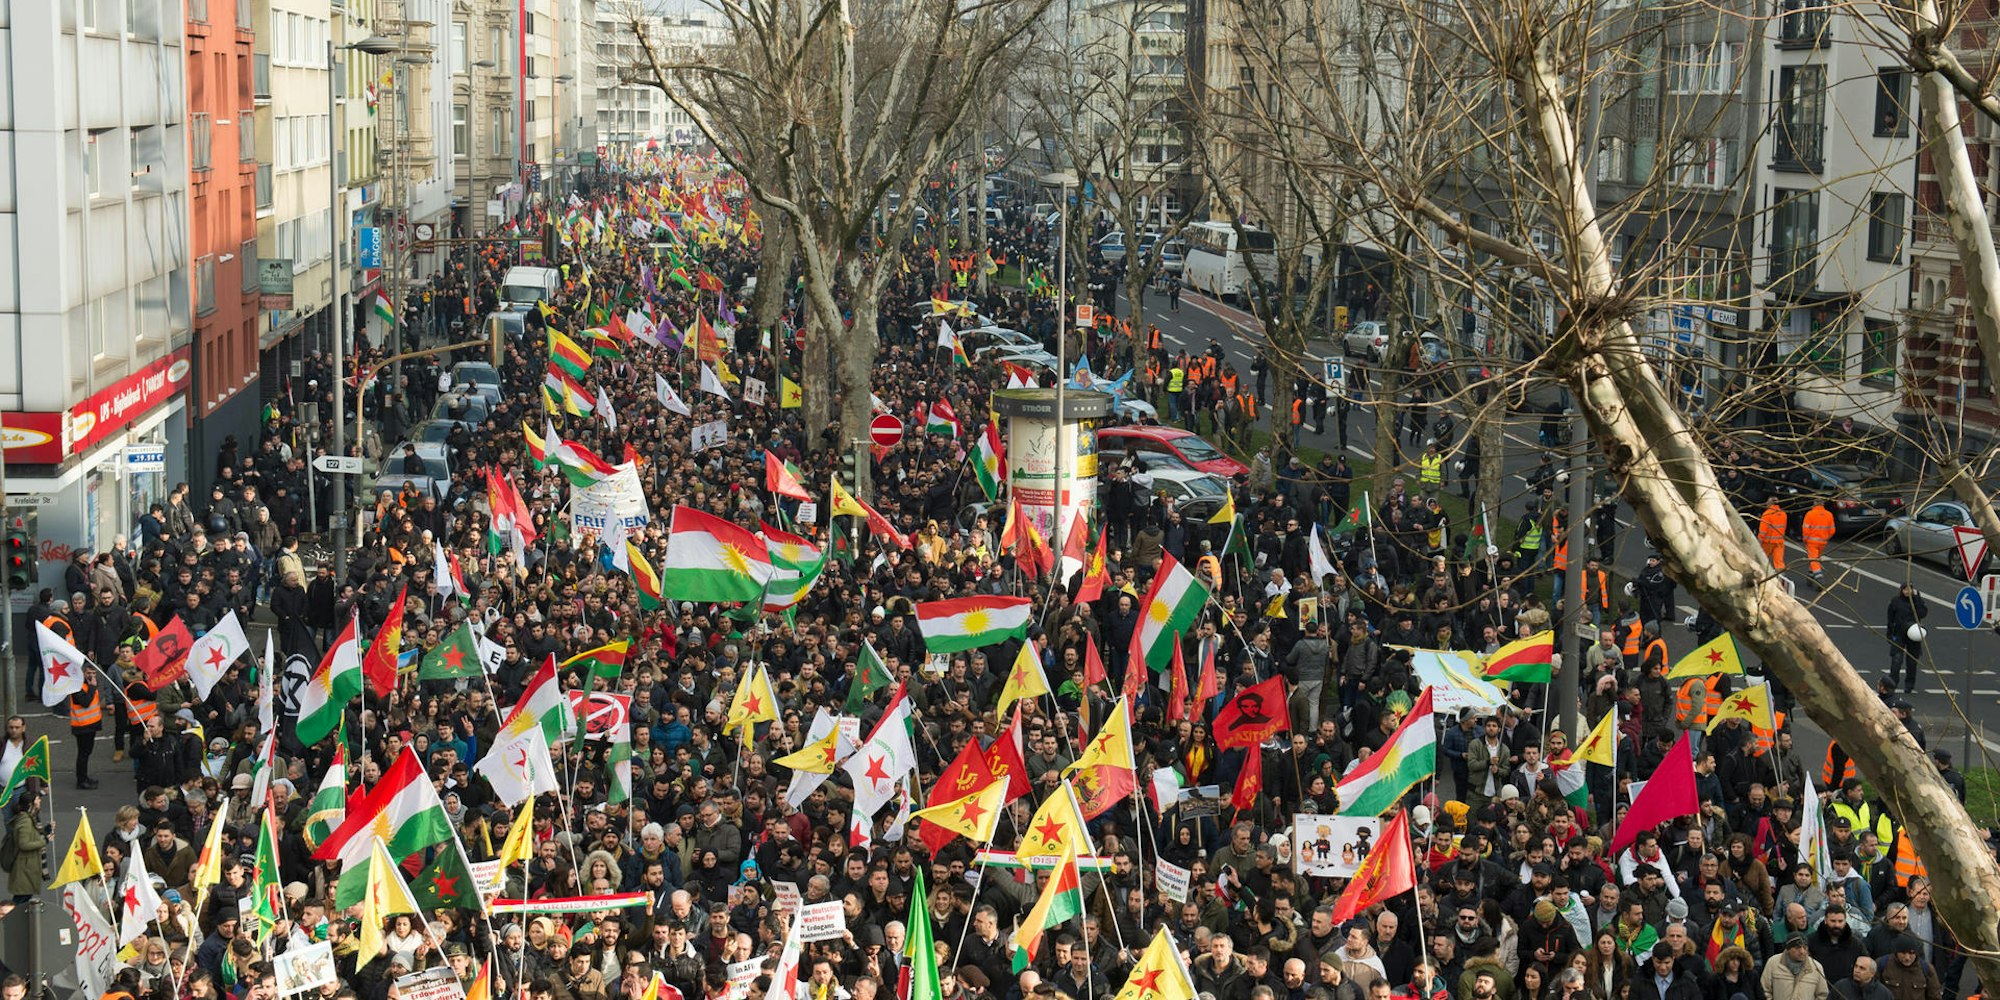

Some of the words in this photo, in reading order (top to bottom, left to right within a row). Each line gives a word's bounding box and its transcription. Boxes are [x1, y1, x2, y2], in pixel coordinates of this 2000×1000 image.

[372, 227, 380, 266] PIAGGIO
[1720, 312, 1737, 326] EMIR
[1021, 404, 1052, 412] STRÖER
[575, 513, 648, 528] FRIEN
[533, 900, 609, 911] KURDISTAN
[806, 923, 835, 931] Erdogans
